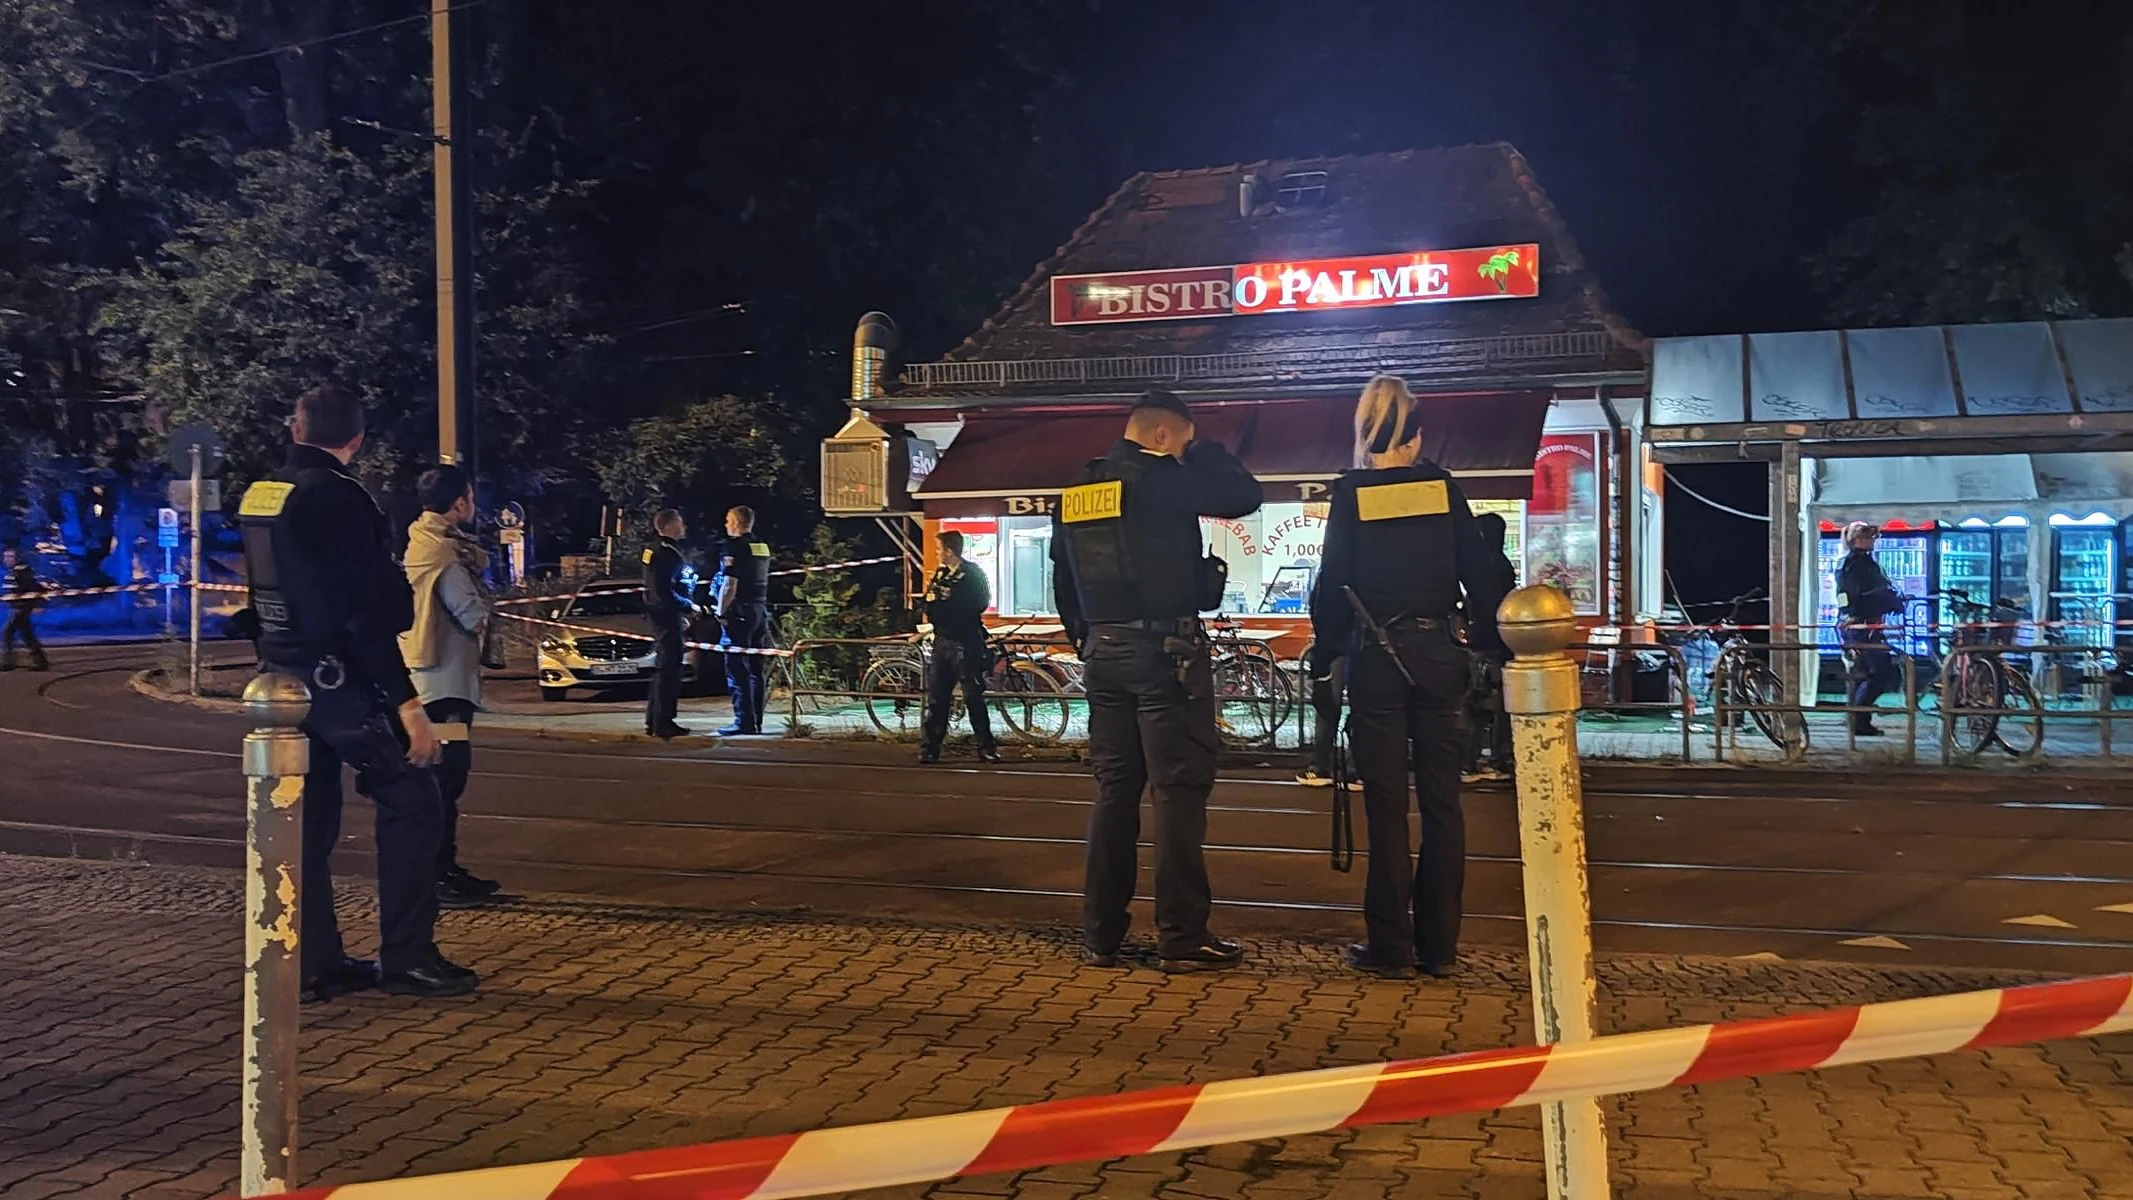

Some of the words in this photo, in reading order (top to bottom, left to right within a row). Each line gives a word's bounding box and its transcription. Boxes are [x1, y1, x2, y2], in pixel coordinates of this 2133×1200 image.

[1097, 275, 1267, 316] BISTRO
[1279, 264, 1449, 304] PALME
[1064, 487, 1117, 518] POLIZEI
[1262, 515, 1311, 556] KAFFEE
